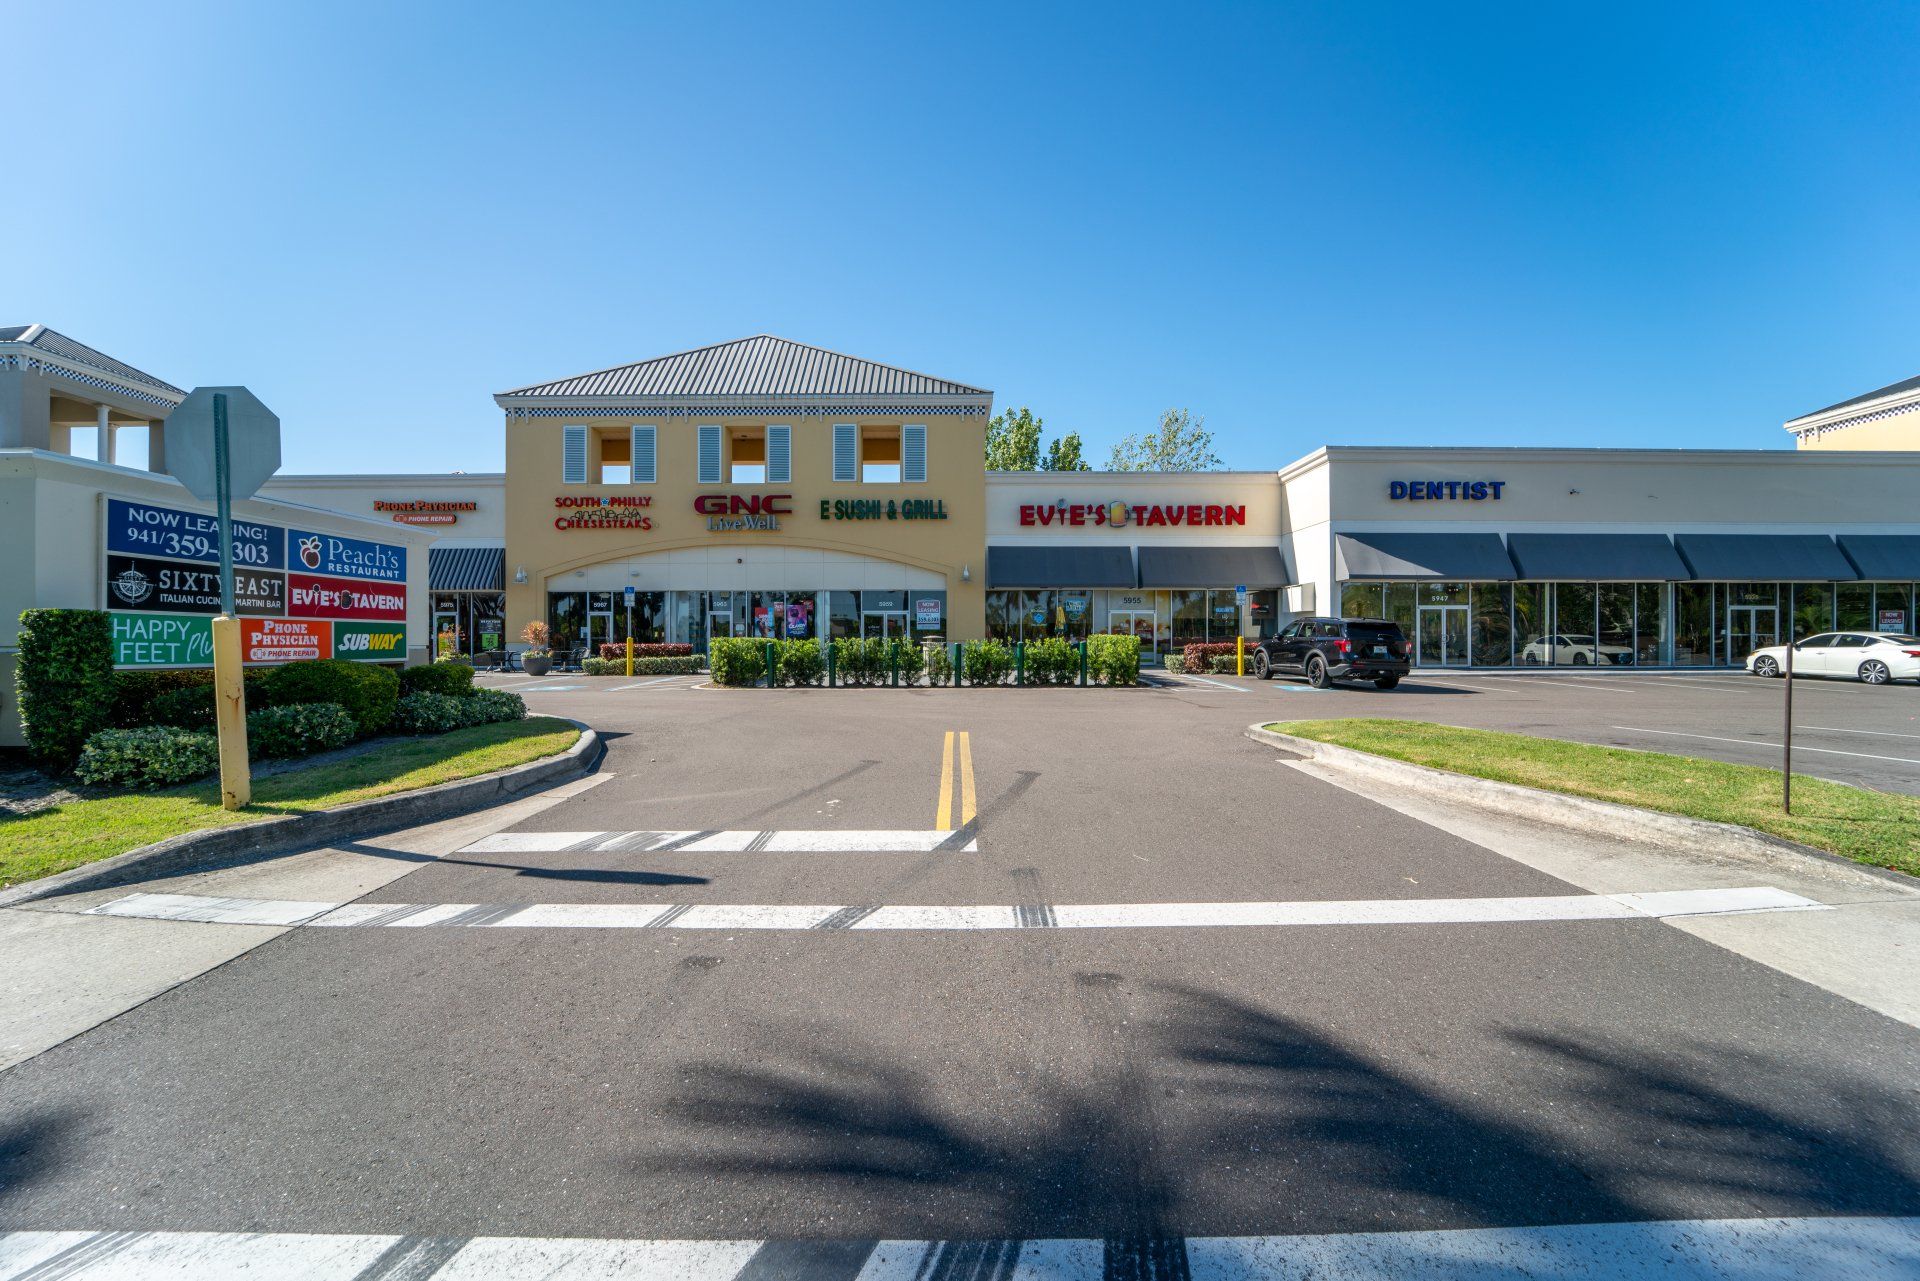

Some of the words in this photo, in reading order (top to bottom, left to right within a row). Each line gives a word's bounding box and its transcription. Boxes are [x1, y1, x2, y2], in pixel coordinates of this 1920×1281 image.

[1390, 480, 1506, 501] DENTIST
[373, 500, 414, 512] PHONE
[415, 499, 477, 511] PHYSICIAN
[555, 496, 601, 508] SOUTH
[610, 496, 652, 507] PHILLY
[693, 494, 793, 514] GNC
[820, 499, 830, 520] E
[834, 499, 881, 520] SUSHI
[886, 499, 897, 520] &
[902, 499, 948, 520] GRILL
[128, 507, 181, 528] NOW
[185, 516, 268, 541] LEAING!
[554, 517, 652, 531] CHEESESTEAKS
[706, 515, 742, 531] Live
[1132, 504, 1246, 527] TAVERN
[127, 527, 269, 565] 941/359-303
[327, 538, 399, 569] Peach's
[328, 562, 400, 579] RESTAURANT
[235, 576, 282, 597] EAST
[160, 593, 194, 604] ITALIAN
[196, 595, 222, 606] CUCIN
[235, 598, 264, 608] MARTINI
[266, 599, 281, 609] BAR
[351, 593, 404, 611] TAVERN
[1123, 596, 1142, 604] 5955
[113, 618, 191, 640] HAPPY
[338, 633, 403, 651] SUBWAY
[120, 641, 181, 663] FEET
[267, 649, 292, 657] PHONE
[293, 649, 317, 657] REPAIR
